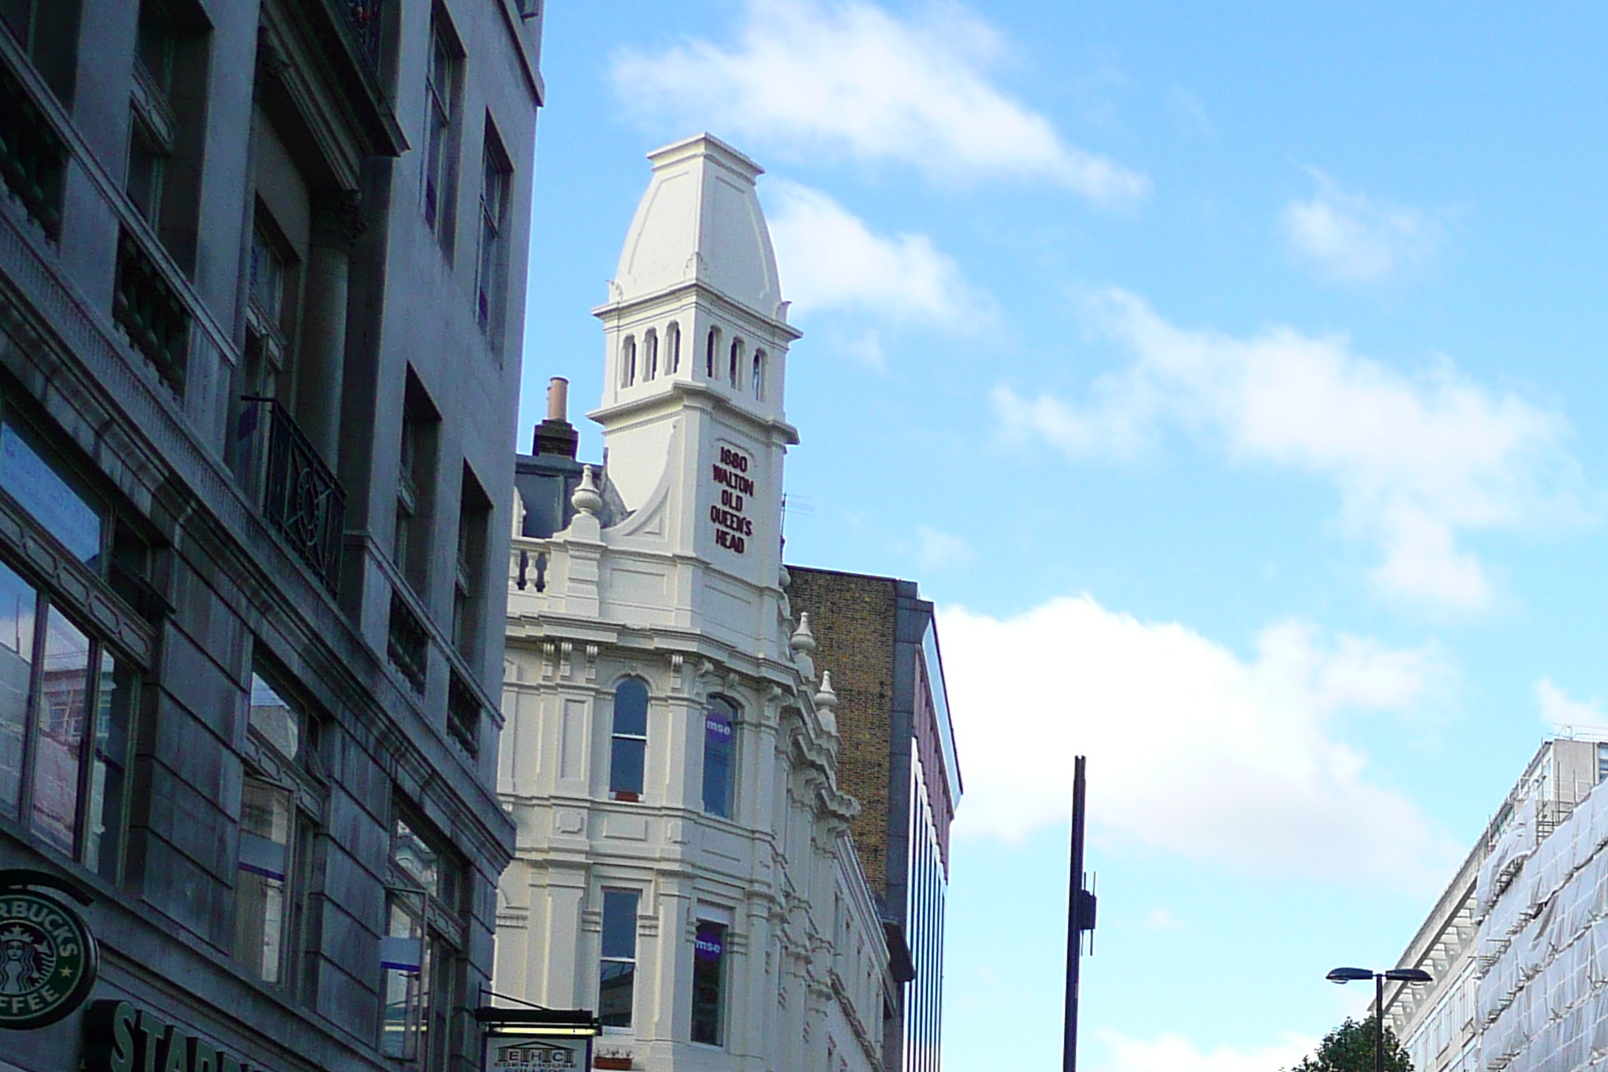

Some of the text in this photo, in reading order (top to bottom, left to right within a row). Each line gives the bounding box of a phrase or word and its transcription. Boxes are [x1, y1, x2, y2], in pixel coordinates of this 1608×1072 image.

[720, 446, 748, 472] 1880
[712, 464, 754, 497] WALTON
[721, 489, 743, 512] OLD
[710, 505, 753, 537] QUEEN'S
[715, 528, 745, 554] HEAD
[695, 941, 721, 953] mse
